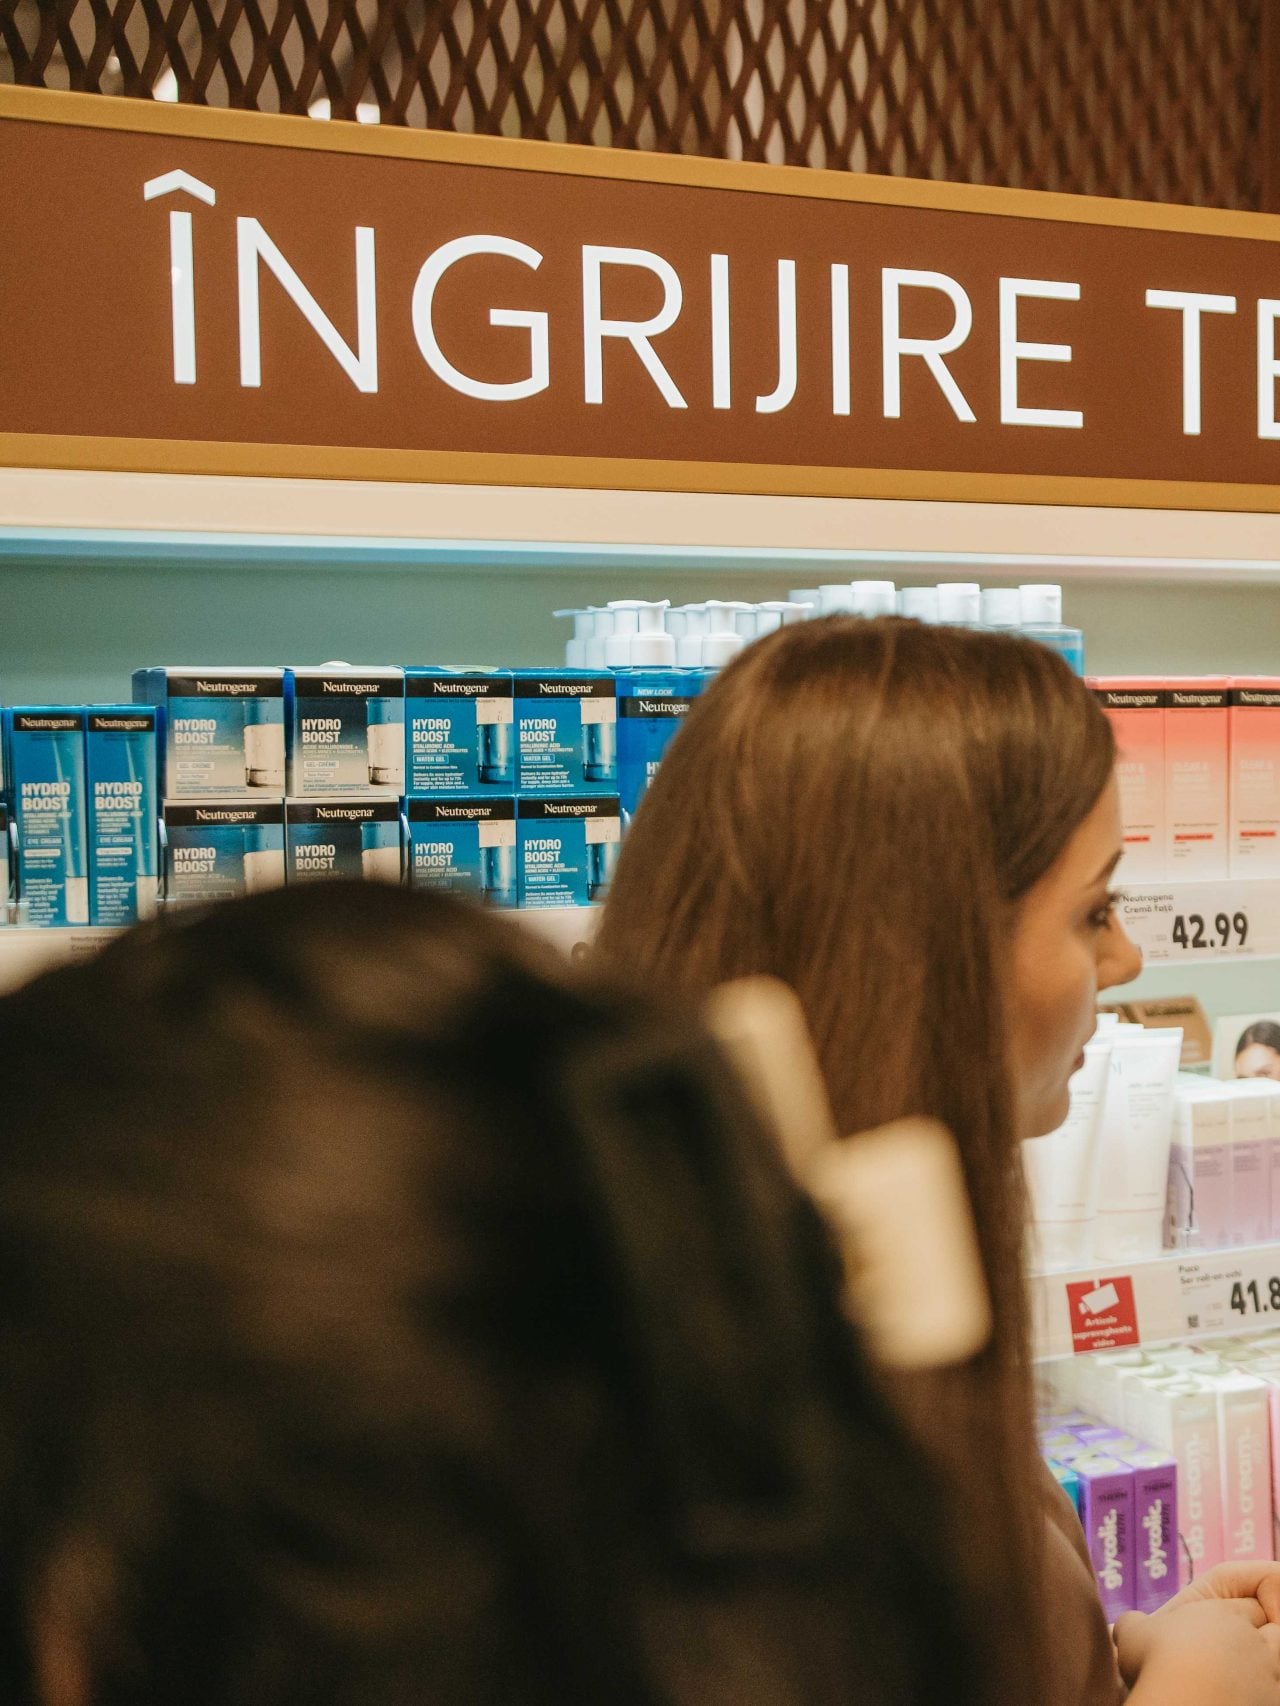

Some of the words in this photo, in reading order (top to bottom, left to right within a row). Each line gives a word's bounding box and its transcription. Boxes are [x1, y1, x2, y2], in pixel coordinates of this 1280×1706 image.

[143, 168, 1083, 428] ÎNGRIJIRE
[196, 680, 258, 695] Neutrogena
[323, 681, 380, 696] Neutrogena
[433, 682, 490, 696] Neutrogena
[539, 682, 594, 696] Neutrogena
[639, 700, 690, 715] Neutrogen
[20, 716, 77, 729] Neutrogena
[94, 717, 150, 730] Neutrogena
[174, 718, 217, 732] HYDRO
[302, 718, 342, 731] HYDRO
[412, 718, 451, 730] HYDRO
[519, 718, 557, 730] HYDRO
[174, 732, 216, 744] BOOST
[302, 731, 341, 743] BOOST
[413, 731, 450, 742] BOOST
[519, 730, 556, 742] BOOST
[22, 782, 71, 796] HYDRO
[94, 781, 143, 796] HYDRO
[22, 796, 70, 811] BOOST
[95, 796, 142, 810] BOOST
[544, 802, 599, 816] Neutrogena
[196, 809, 257, 822] Neutrogena
[316, 807, 375, 821] Neutrogena
[435, 804, 492, 818] Neutrogena
[295, 844, 336, 857] HYDRO
[415, 842, 454, 855] HYDRO
[524, 838, 562, 851] HYDRO
[174, 847, 217, 861] HYDRO
[415, 854, 453, 867] BOOST
[525, 851, 561, 863] BOOST
[174, 860, 216, 873] BOOST
[296, 857, 335, 870] BOOST
[1172, 911, 1249, 949] 42.99
